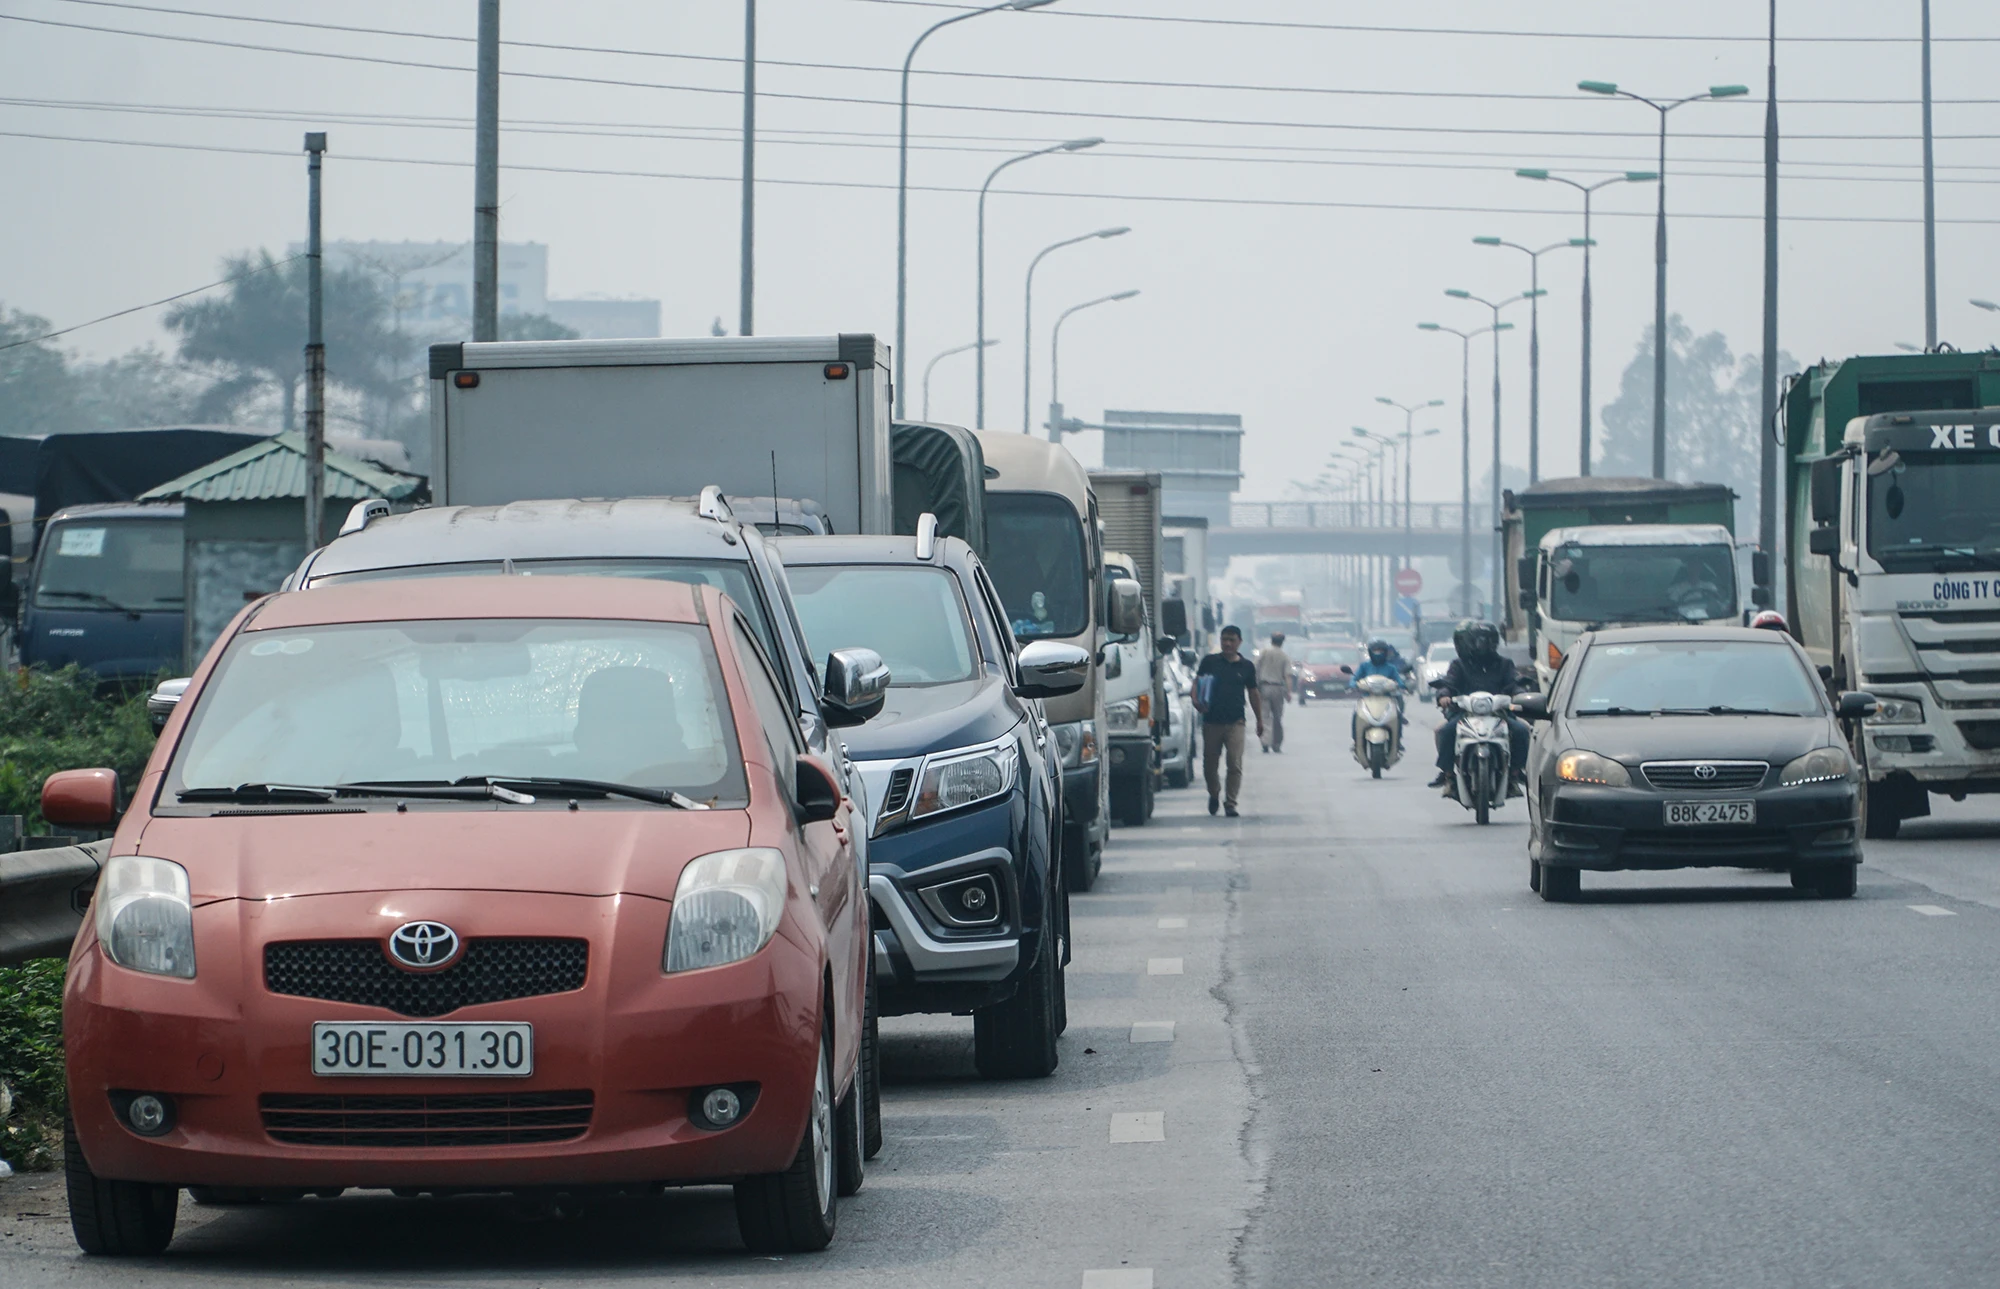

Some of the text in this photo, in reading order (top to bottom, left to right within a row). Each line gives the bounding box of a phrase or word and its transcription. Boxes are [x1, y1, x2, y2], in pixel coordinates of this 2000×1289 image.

[1930, 424, 1975, 449] XE
[1933, 577, 1970, 600] CÔNG
[1973, 580, 1988, 599] TY
[321, 1030, 523, 1069] 30E-031.30
